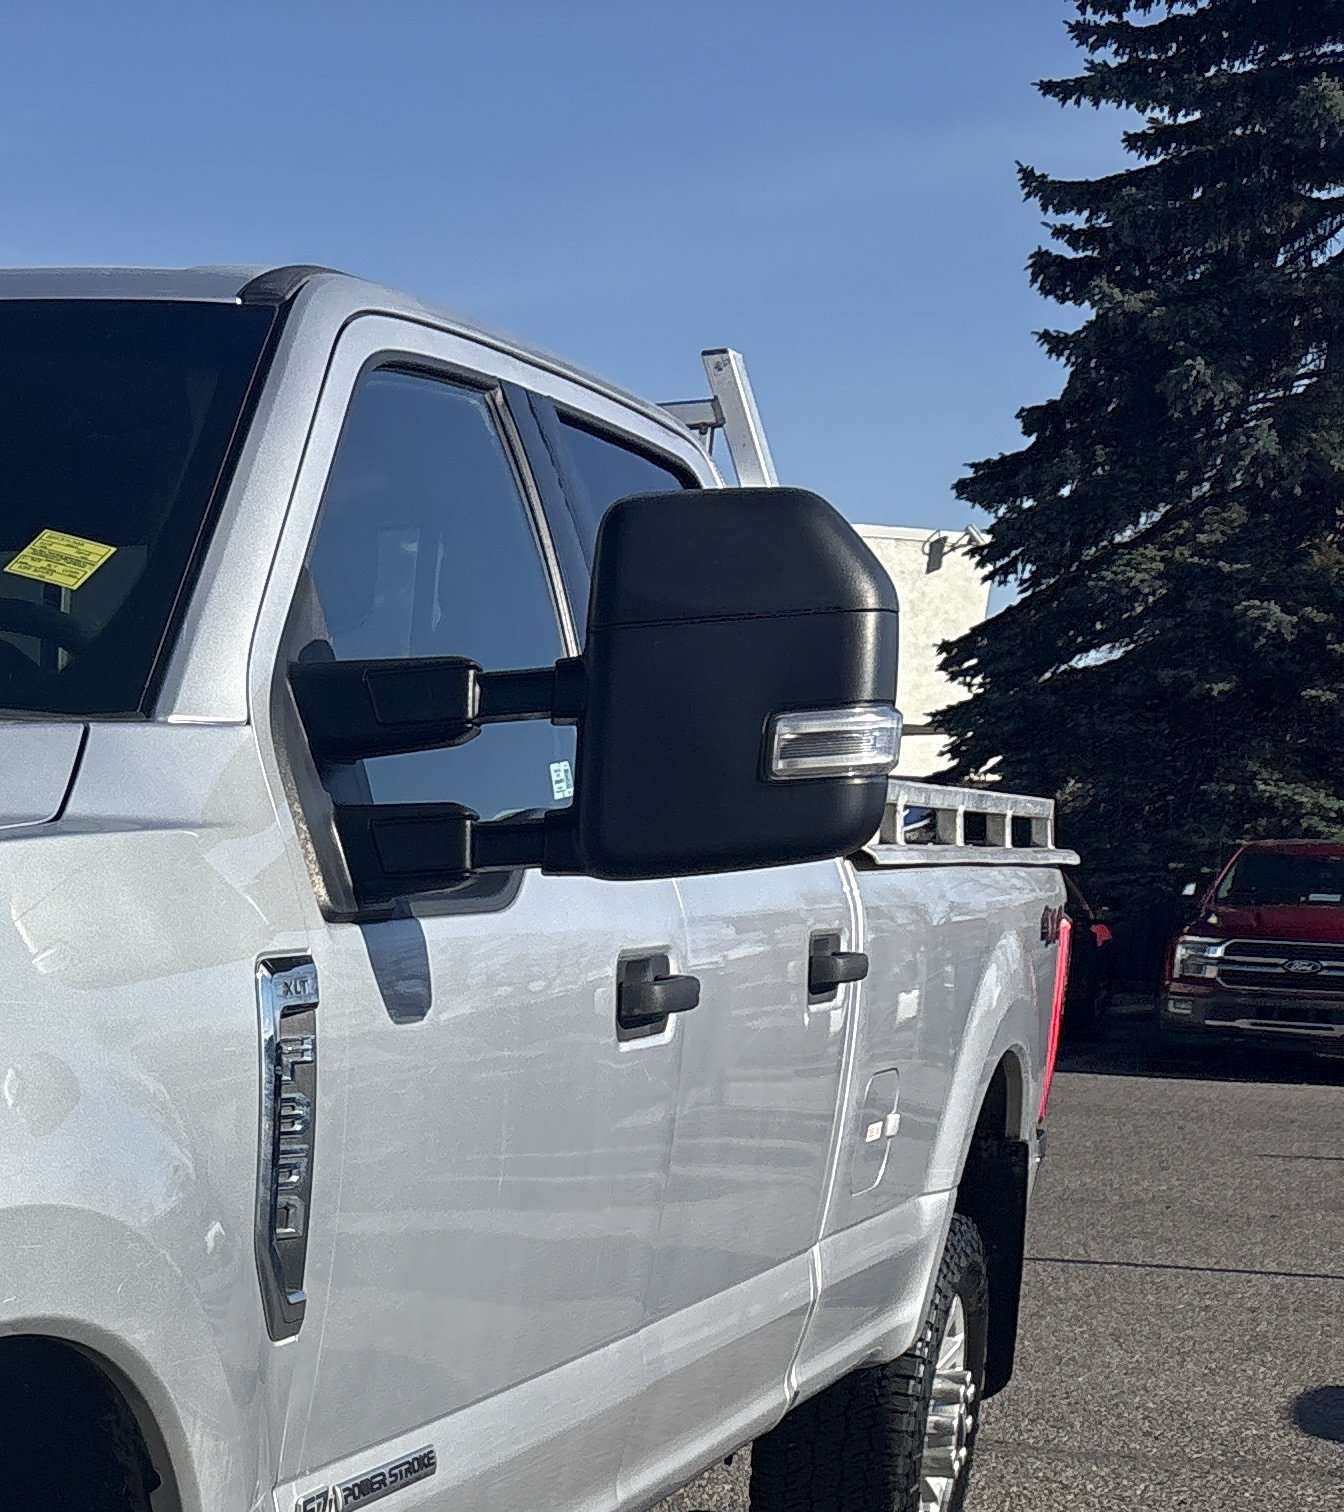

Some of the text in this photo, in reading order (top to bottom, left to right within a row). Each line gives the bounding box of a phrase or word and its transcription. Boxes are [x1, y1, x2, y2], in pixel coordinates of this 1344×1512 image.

[282, 979, 309, 996] XLT
[342, 1471, 388, 1506] POWER
[388, 1449, 437, 1486] STROKE
